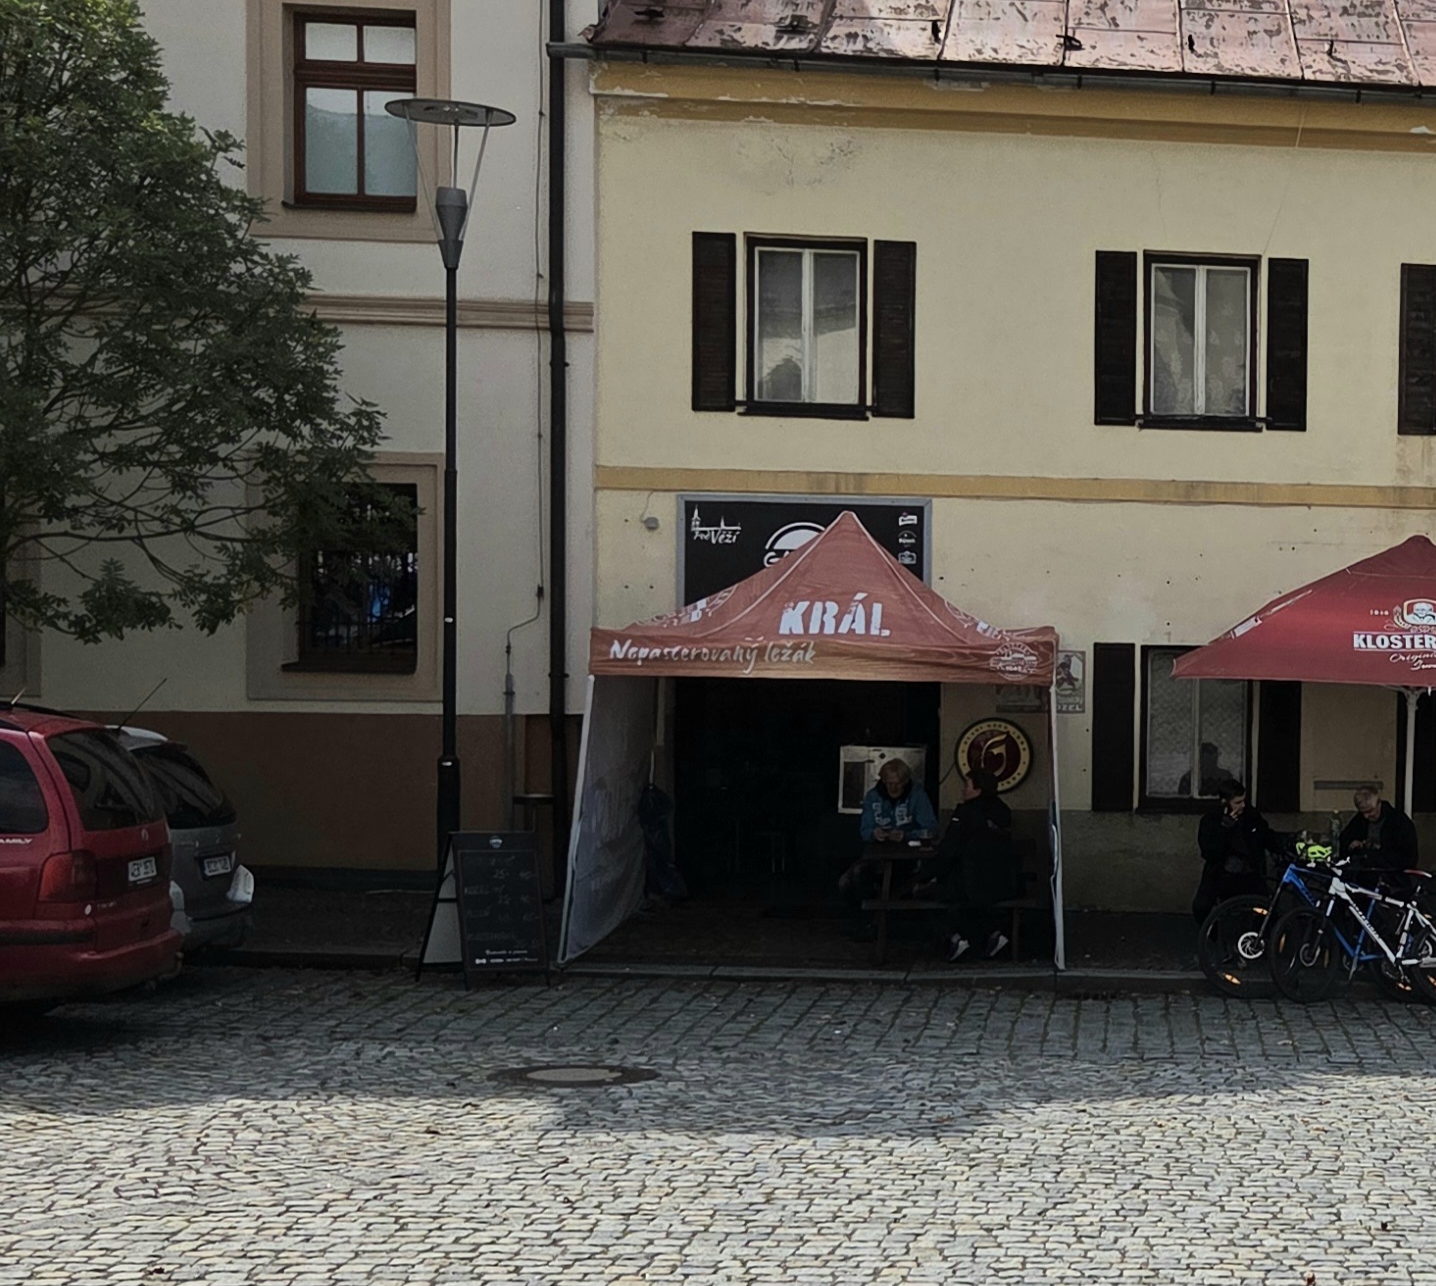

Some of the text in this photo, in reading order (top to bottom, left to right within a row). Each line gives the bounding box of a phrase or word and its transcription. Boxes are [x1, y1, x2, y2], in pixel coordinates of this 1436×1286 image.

[711, 530, 740, 544] Věží
[778, 592, 891, 636] KRÁL
[765, 641, 817, 664] ležák
[1057, 704, 1083, 712] OZEL
